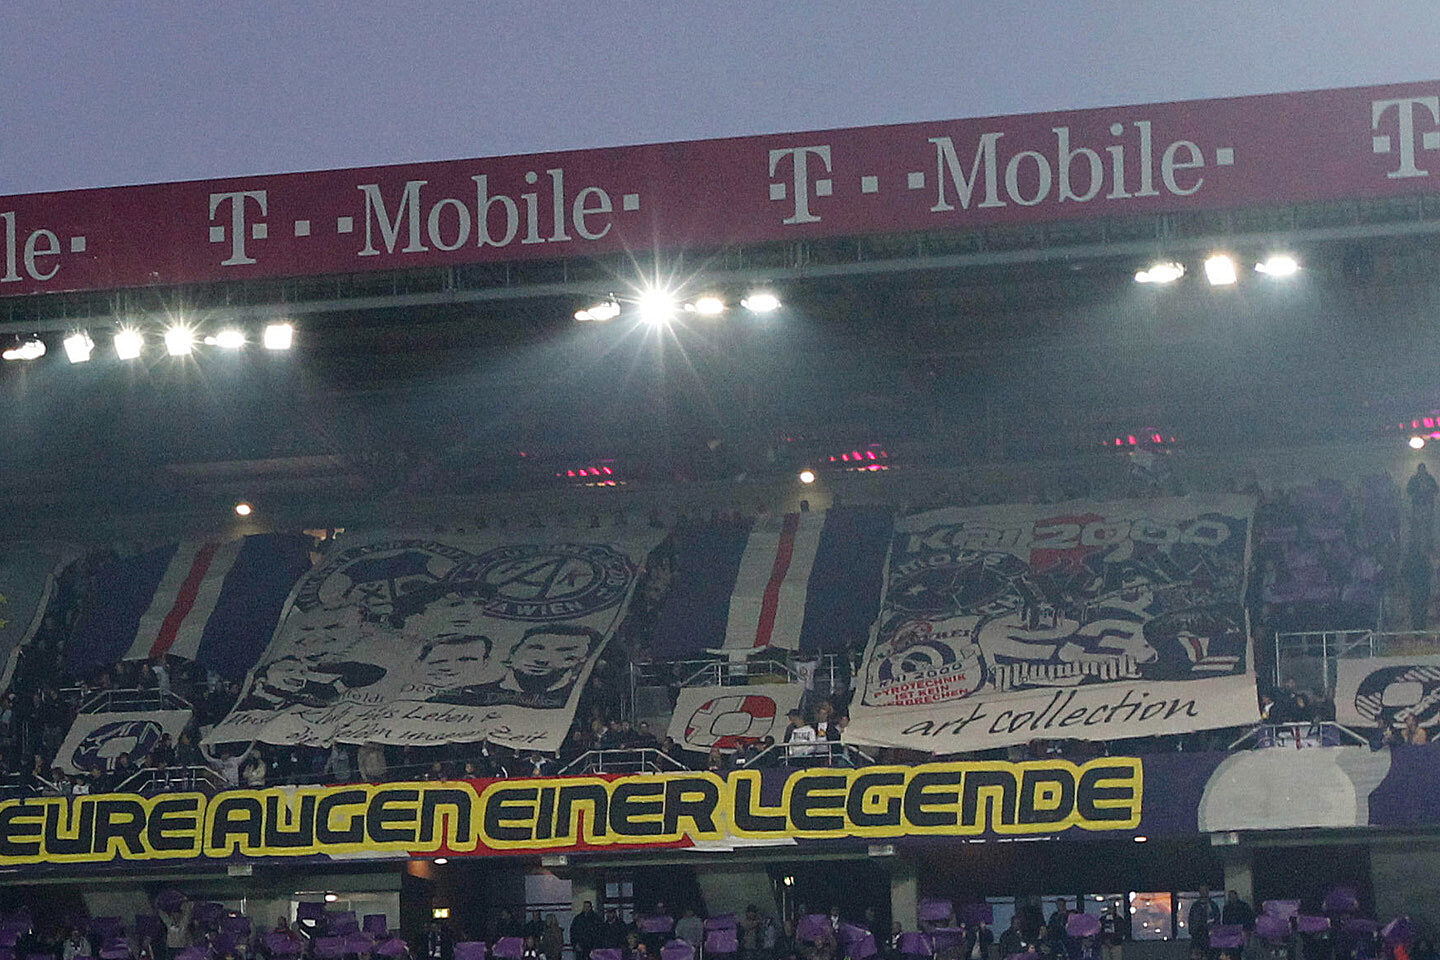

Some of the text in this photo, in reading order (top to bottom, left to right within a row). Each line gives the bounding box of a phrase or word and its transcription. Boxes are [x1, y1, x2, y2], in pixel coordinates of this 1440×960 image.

[927, 120, 1206, 213] Mobile
[357, 168, 614, 257] Mobile
[873, 672, 966, 699] PYROTECHNIK
[894, 685, 950, 701] IST KEIN
[901, 689, 1200, 738] art collection
[211, 788, 471, 850] AUGEN
[483, 777, 721, 841] EINER
[733, 763, 1136, 833] LEGENDE
